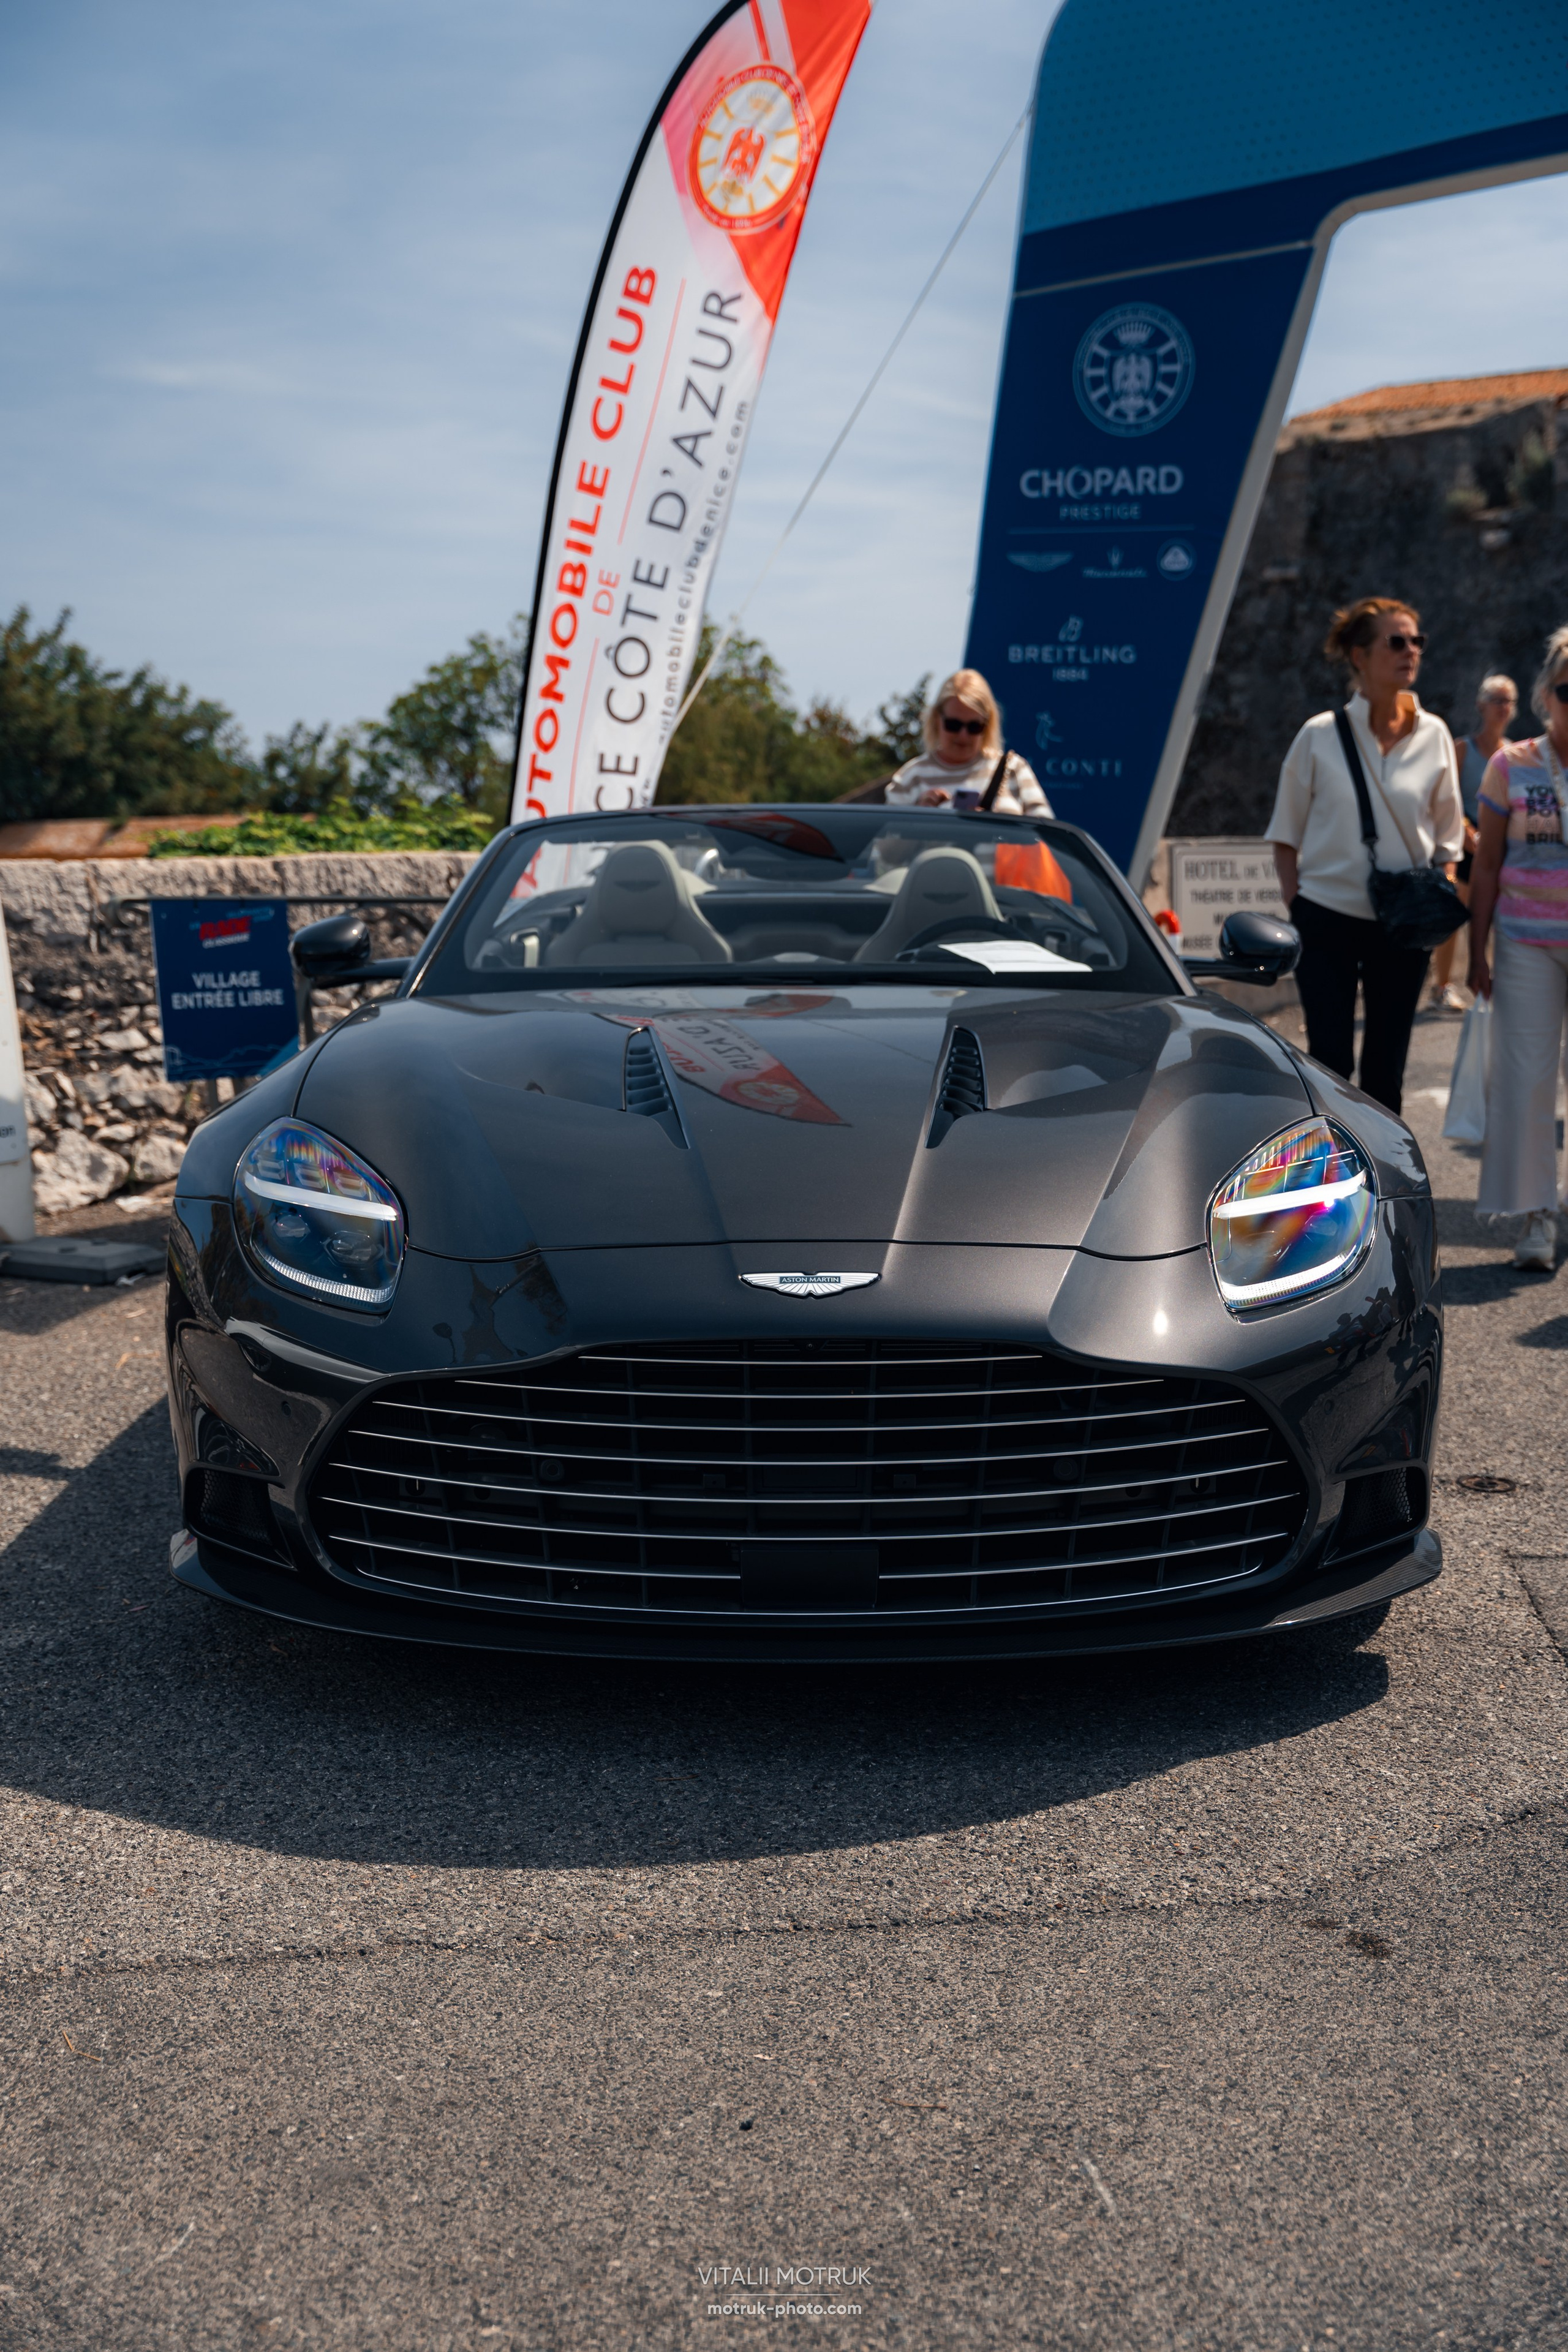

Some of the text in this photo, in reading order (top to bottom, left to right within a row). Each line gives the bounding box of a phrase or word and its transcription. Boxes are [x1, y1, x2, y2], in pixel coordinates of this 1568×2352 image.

[590, 265, 658, 441] CLUB
[1019, 464, 1184, 499] CHOPARD
[605, 559, 669, 725] CÔTE
[647, 290, 744, 532] D'AZUR
[1059, 503, 1141, 521] PRESTIGE
[592, 568, 620, 616] DE
[1008, 645, 1137, 663] BREITLING
[1046, 757, 1123, 777] CONTI
[192, 970, 261, 989] VILLAGE
[171, 989, 284, 1010] ENTRÉE LIBRE
